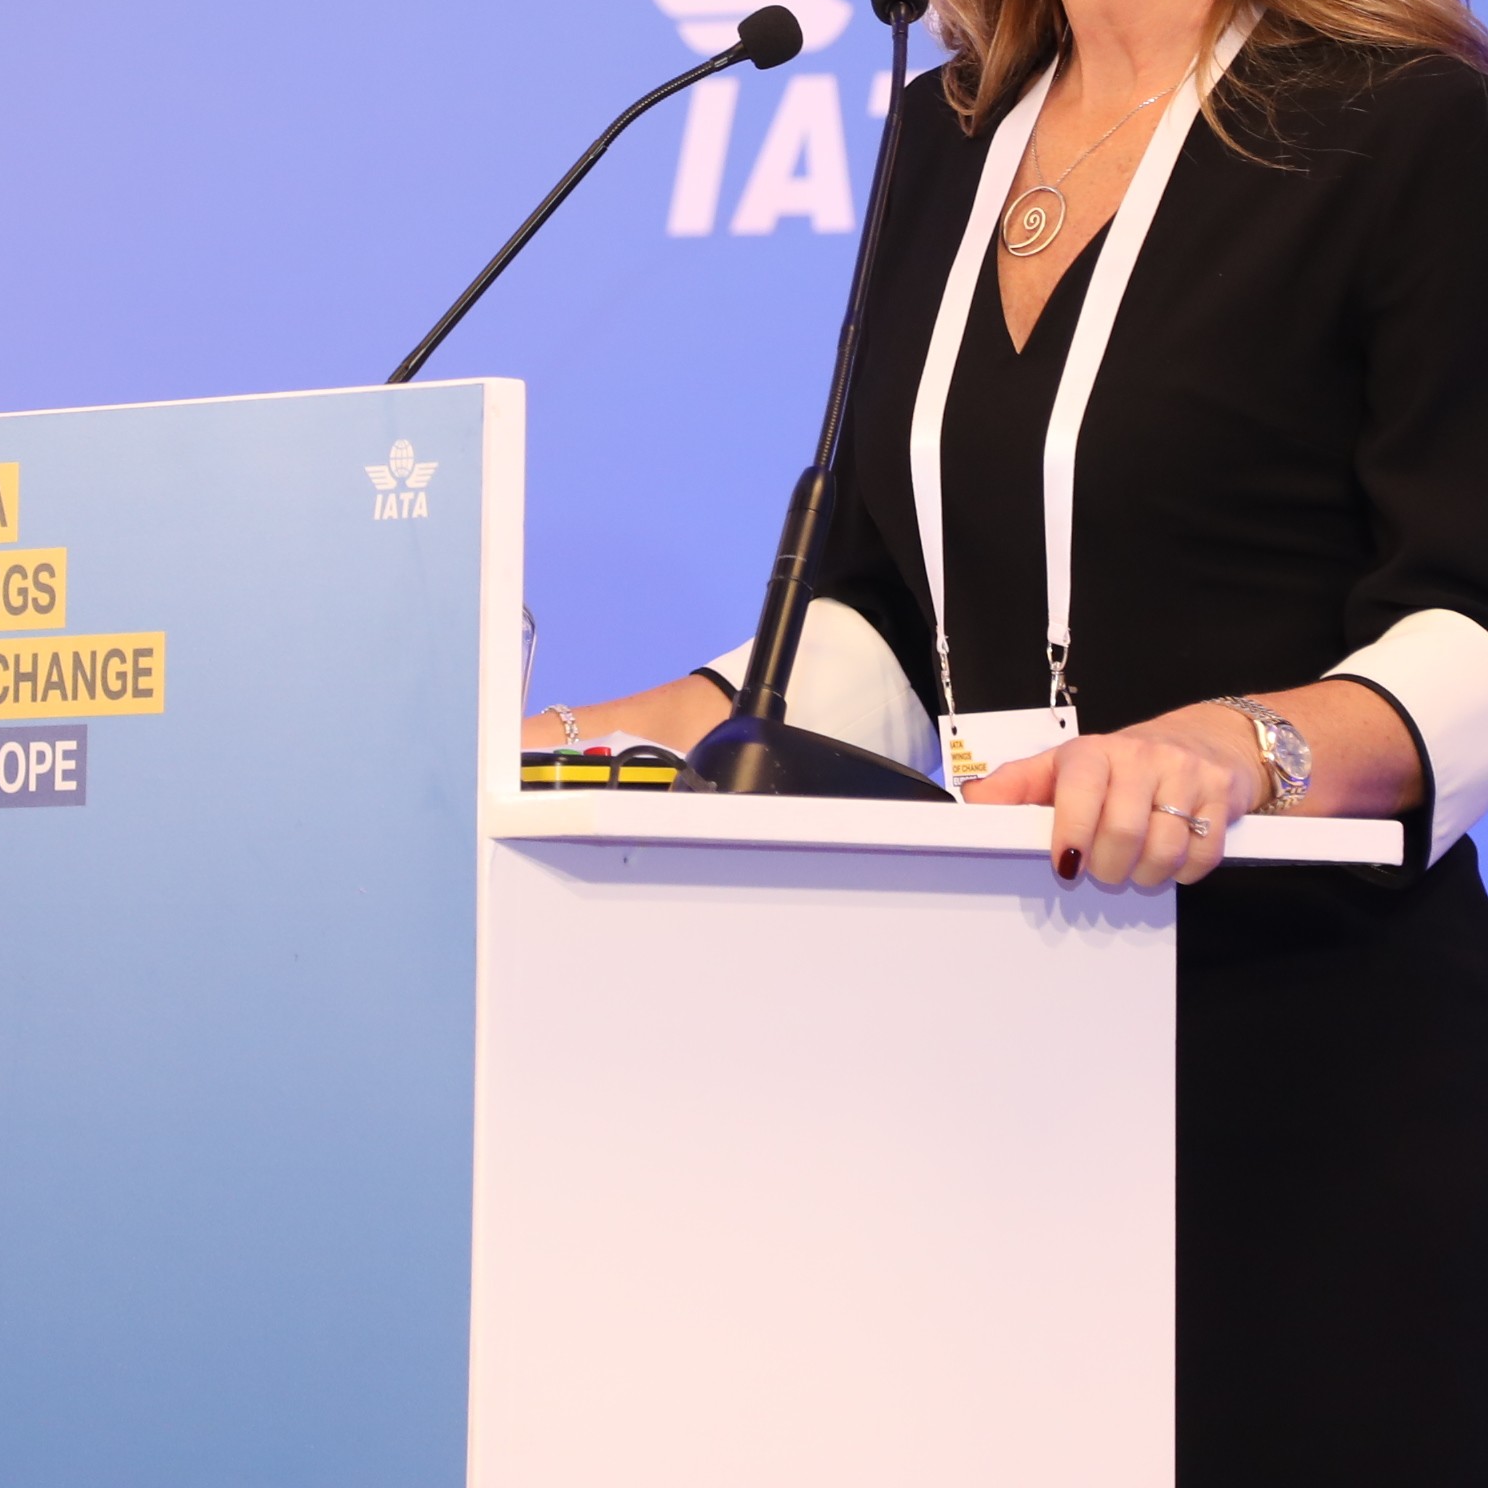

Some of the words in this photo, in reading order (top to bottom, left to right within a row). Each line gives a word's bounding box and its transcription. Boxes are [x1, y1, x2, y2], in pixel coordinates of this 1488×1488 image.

[665, 70, 924, 238] IA
[373, 491, 429, 520] IATA
[962, 762, 987, 772] CHANGE
